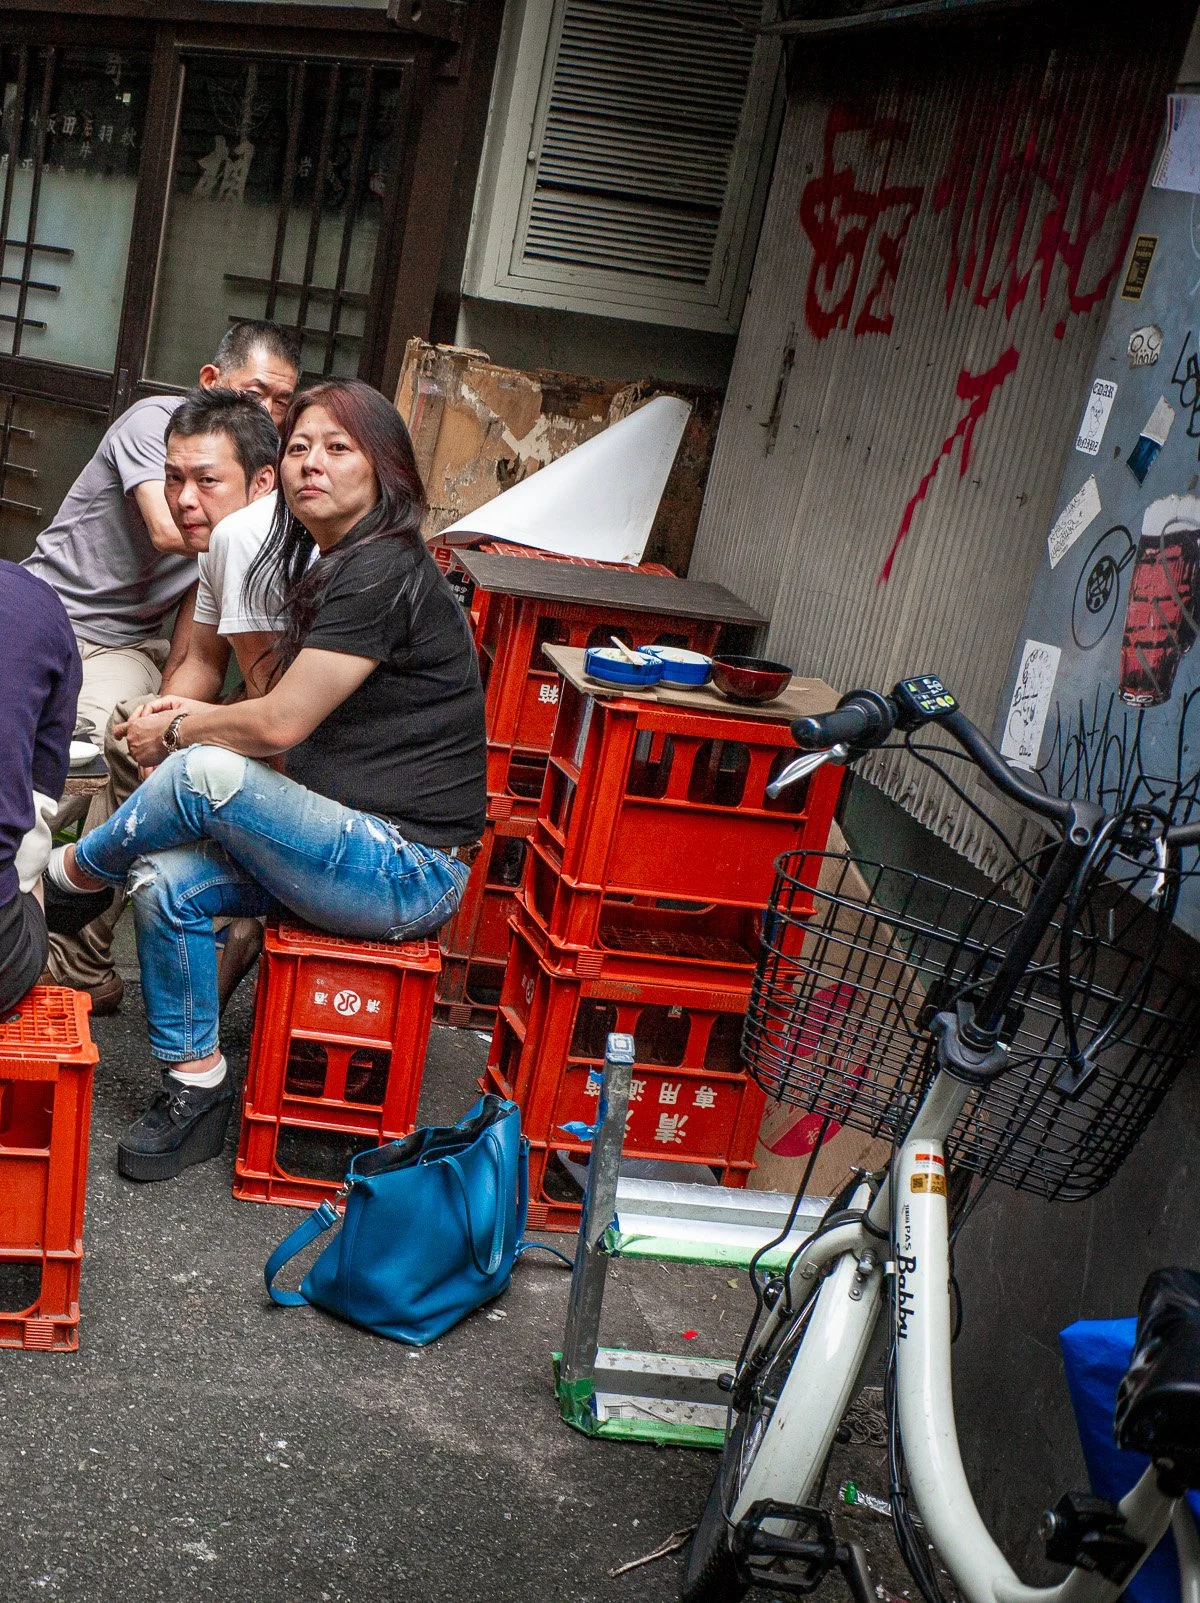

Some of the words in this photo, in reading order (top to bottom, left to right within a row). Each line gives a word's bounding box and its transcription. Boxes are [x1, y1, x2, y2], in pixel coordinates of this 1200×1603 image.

[538, 684, 559, 704] 箱
[904, 1225, 912, 1251] PAS
[897, 1247, 917, 1341] Babby
